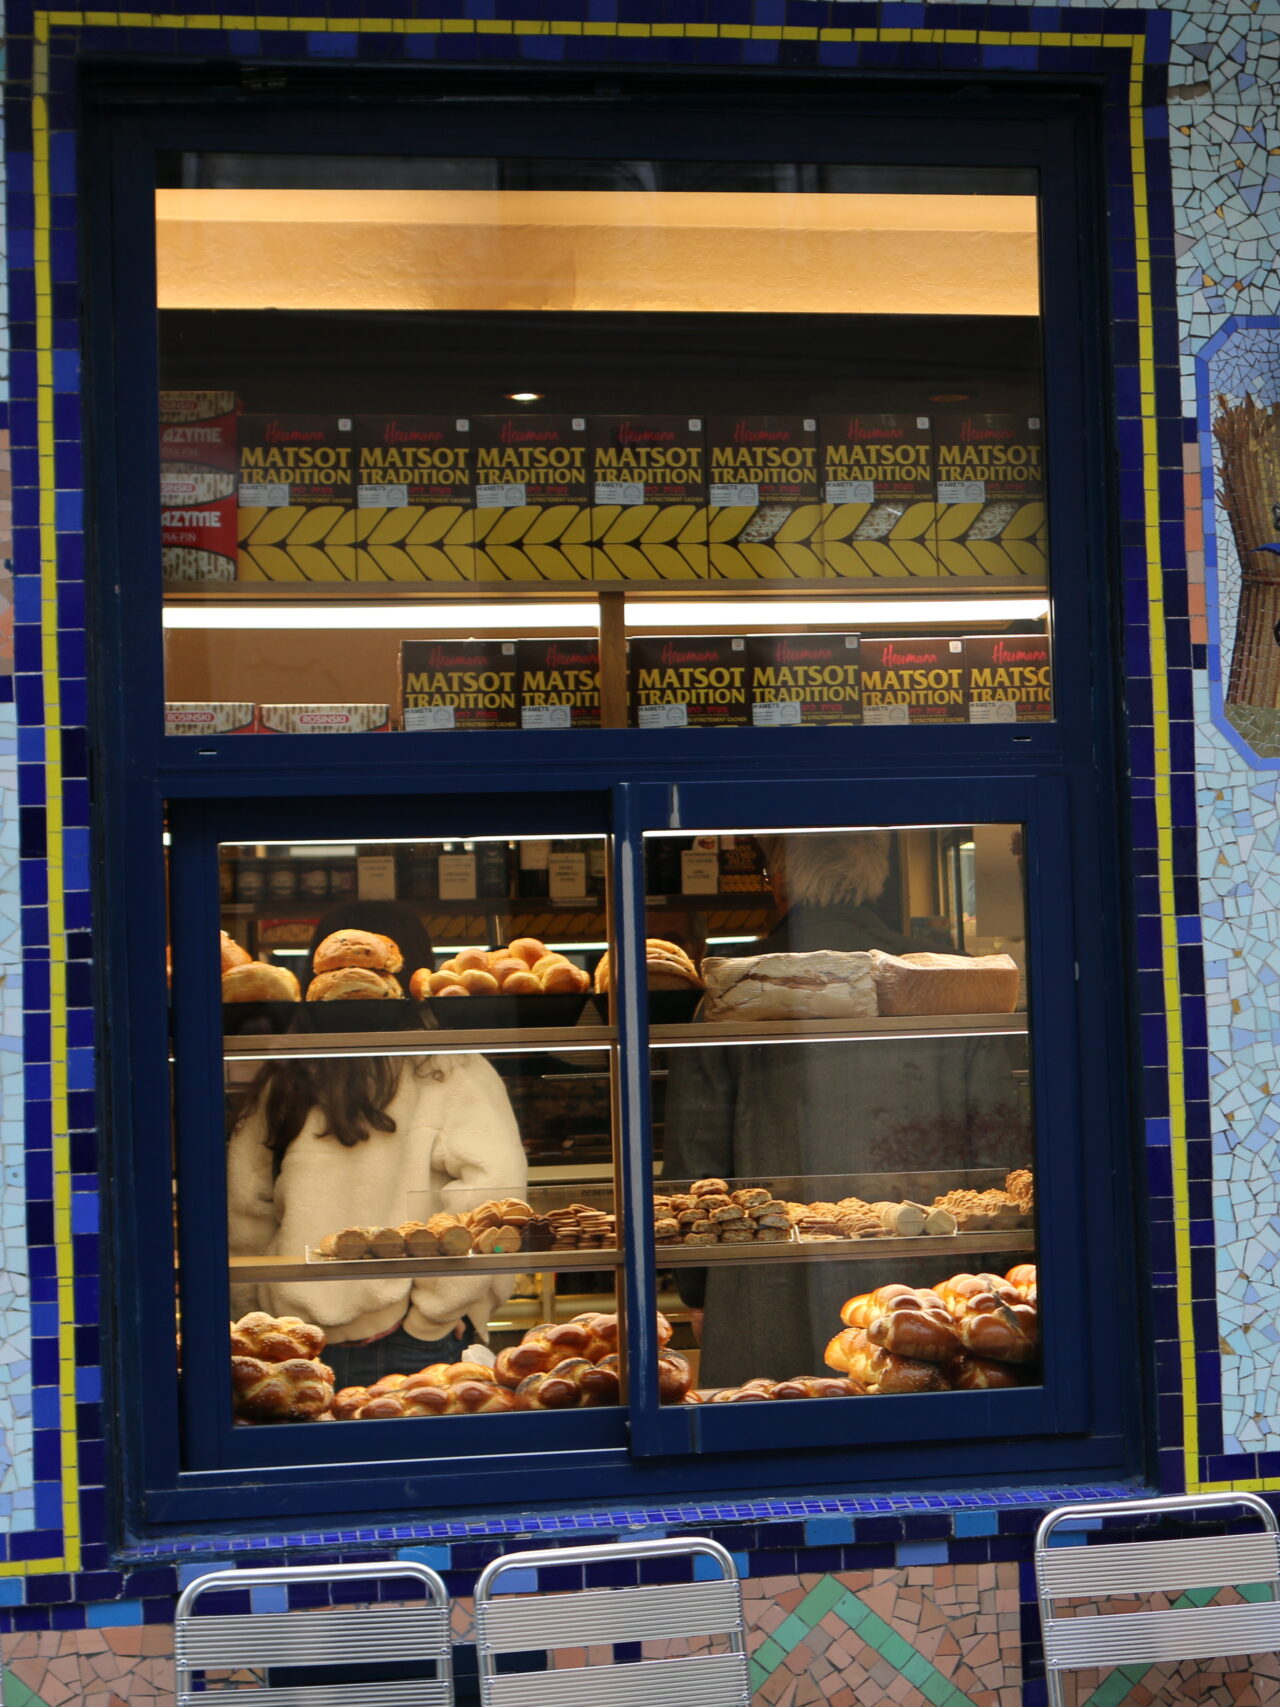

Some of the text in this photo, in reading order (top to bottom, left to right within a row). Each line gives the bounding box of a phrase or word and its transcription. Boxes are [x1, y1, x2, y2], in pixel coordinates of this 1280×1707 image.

[163, 428, 222, 442] AZYME
[240, 447, 351, 468] MATSOT
[360, 448, 470, 468] MATSOT
[477, 447, 585, 468] MATSOT
[595, 447, 702, 468] MATSOT
[711, 447, 816, 468] MATSOT
[826, 445, 930, 465] MATSOT
[938, 445, 1041, 465] MATSOT
[240, 469, 351, 485] TRADITION
[359, 469, 470, 485] TRADITION
[476, 469, 586, 485] TRADITION
[594, 468, 702, 484] TRADITION
[711, 468, 816, 484] TRADITION
[825, 466, 931, 481] TRADITION
[938, 466, 1041, 481] TRADITION
[162, 511, 221, 527] AZYME
[406, 672, 515, 693] MATSOT
[523, 670, 600, 691] MATS
[638, 667, 745, 689] MATSOT
[753, 665, 859, 686] MATSOT
[861, 668, 963, 690] MATSOT
[970, 666, 1050, 688] MATSO
[406, 693, 515, 709] TRADITION
[522, 691, 599, 707] TRADITI
[637, 689, 745, 705] TRADITION
[753, 686, 859, 702] TRADITION
[862, 690, 963, 706] TRADITION
[302, 715, 345, 724] ROSINSKI
